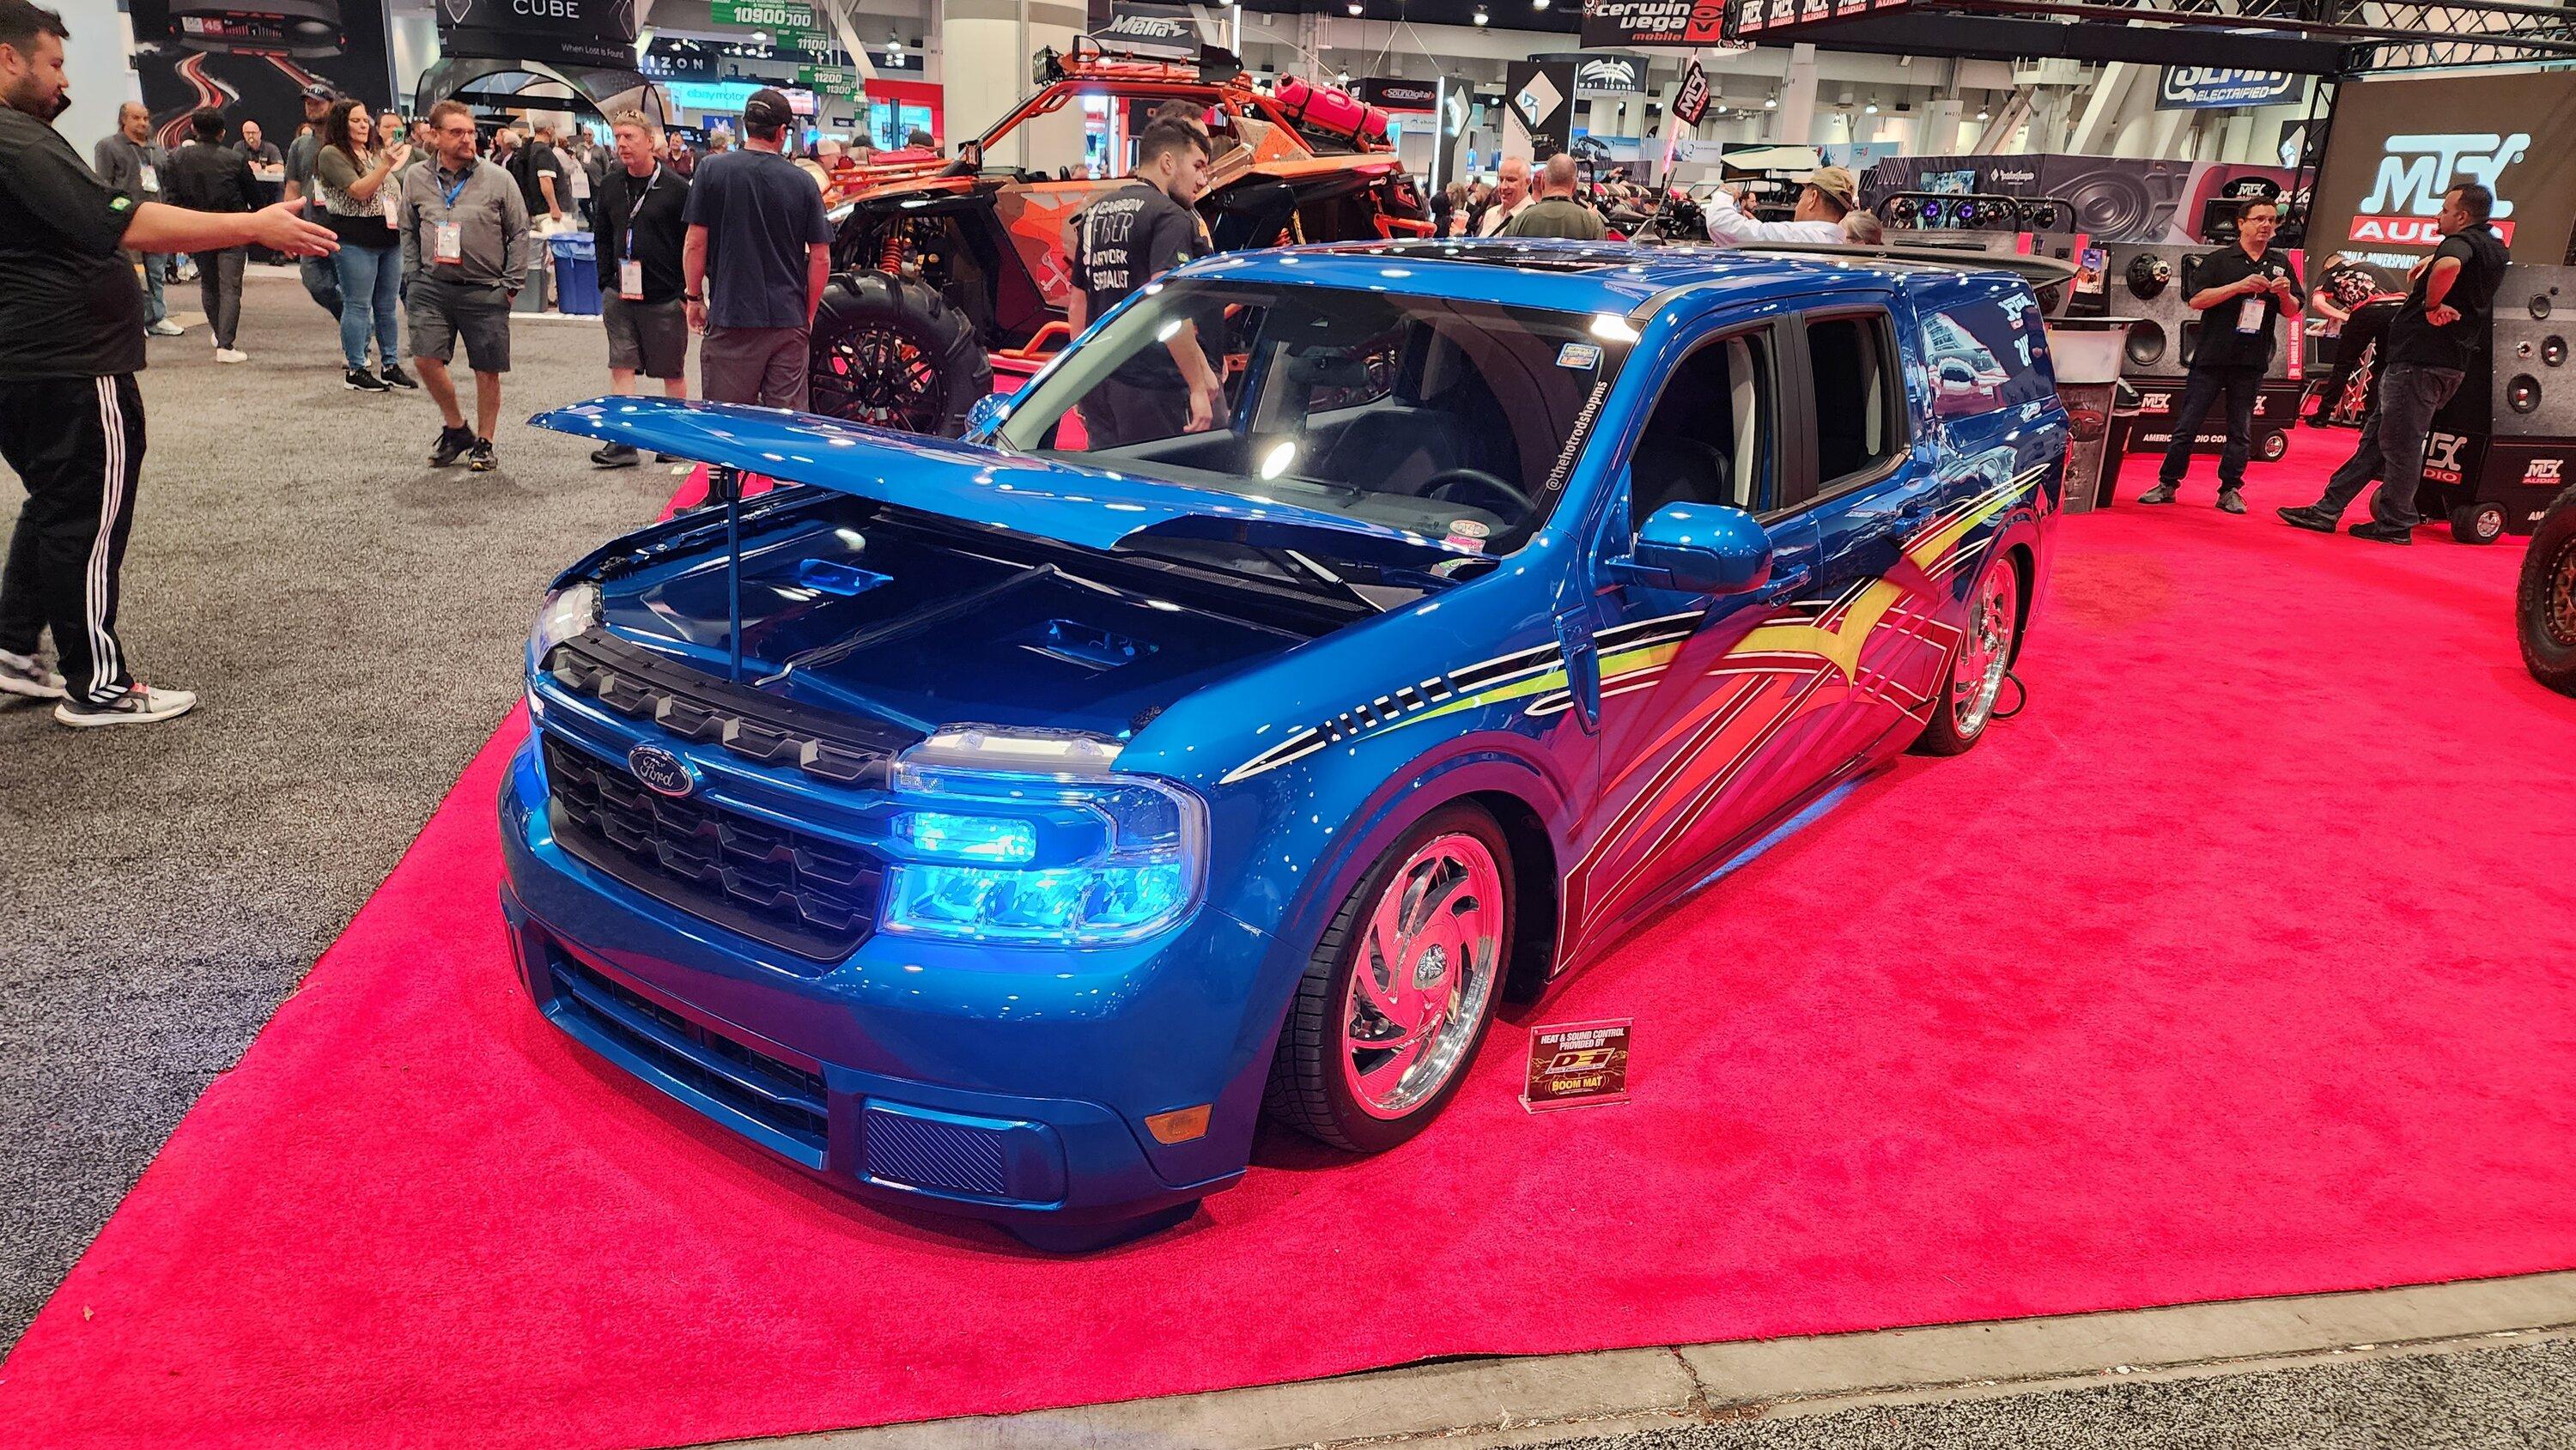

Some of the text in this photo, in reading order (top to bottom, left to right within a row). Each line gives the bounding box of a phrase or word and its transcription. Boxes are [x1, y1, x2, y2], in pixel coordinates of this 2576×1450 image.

[513, 0, 580, 19] CUBE
[1596, 0, 1692, 16] cerwin
[1837, 3, 1866, 15] AUDIO
[734, 7, 786, 25] 10900
[1769, 15, 1795, 27] AUDIO
[1801, 10, 1829, 21] AUDIO
[1619, 15, 1687, 32] vega
[1739, 23, 1762, 33] AUDIO
[1632, 31, 1681, 41] mobile
[562, 44, 584, 54] When
[607, 49, 624, 58] Found
[797, 38, 827, 50] 11100
[814, 73, 842, 83] 11200
[687, 89, 745, 100] ebay motor
[2195, 87, 2269, 101] ELECTRIFIED
[2360, 133, 2531, 218] MTX
[2237, 184, 2267, 196] MTX
[2366, 252, 2421, 269] POWERSPORTS
[2142, 393, 2172, 408] MTX
[1546, 380, 1607, 491] @thehotrodshopms
[2423, 469, 2458, 482] DIO
[2524, 459, 2564, 478] MTX
[640, 756, 674, 786] Ford
[1540, 1028, 1625, 1045] HEAT & SOUND CONTROL
[1559, 1038, 1606, 1051] PROVIDED BY
[1552, 1080, 1581, 1091] BOOM
[1583, 1076, 1603, 1087] MAT
